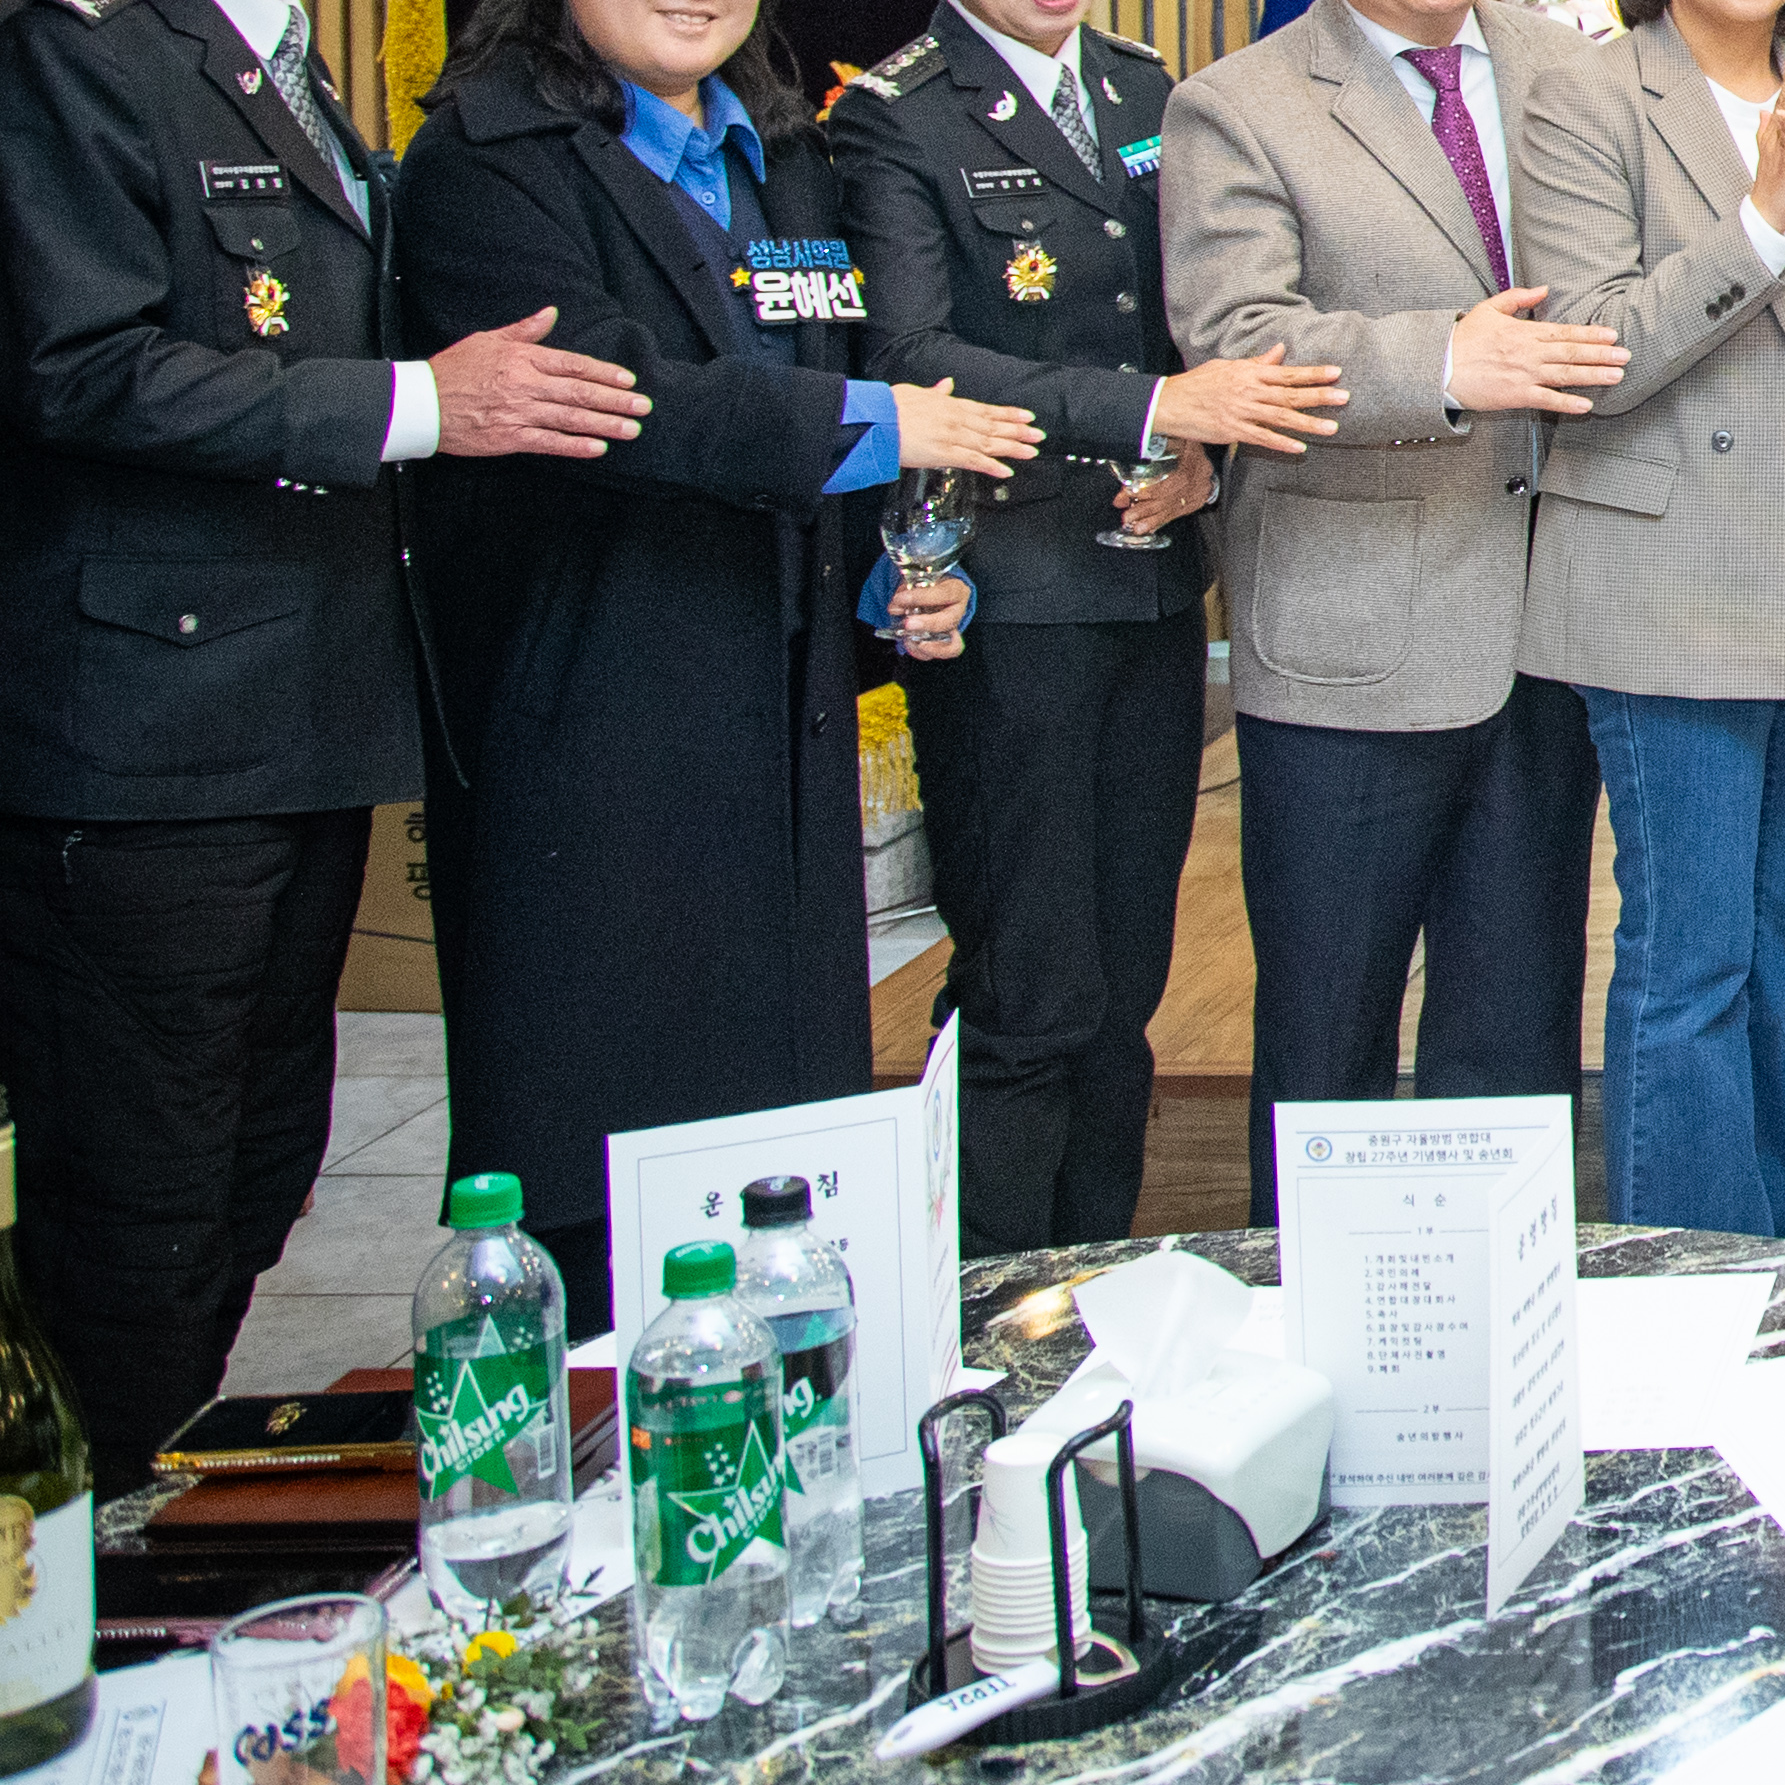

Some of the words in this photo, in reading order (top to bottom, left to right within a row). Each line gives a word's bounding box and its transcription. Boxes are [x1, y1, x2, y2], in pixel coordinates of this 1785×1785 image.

[747, 238, 852, 270] 성남시의원
[753, 270, 867, 321] 윤혜선
[1368, 1134, 1402, 1147] 중원구
[1406, 1133, 1453, 1146] 자율방범
[1456, 1131, 1492, 1145] 연합대
[1344, 1151, 1367, 1164] 창립
[1371, 1150, 1408, 1164] 27주년
[1412, 1149, 1459, 1163] 기념행사
[1464, 1148, 1474, 1161] 및
[1478, 1147, 1514, 1161] 송년회
[421, 1383, 530, 1482] Chilsung
